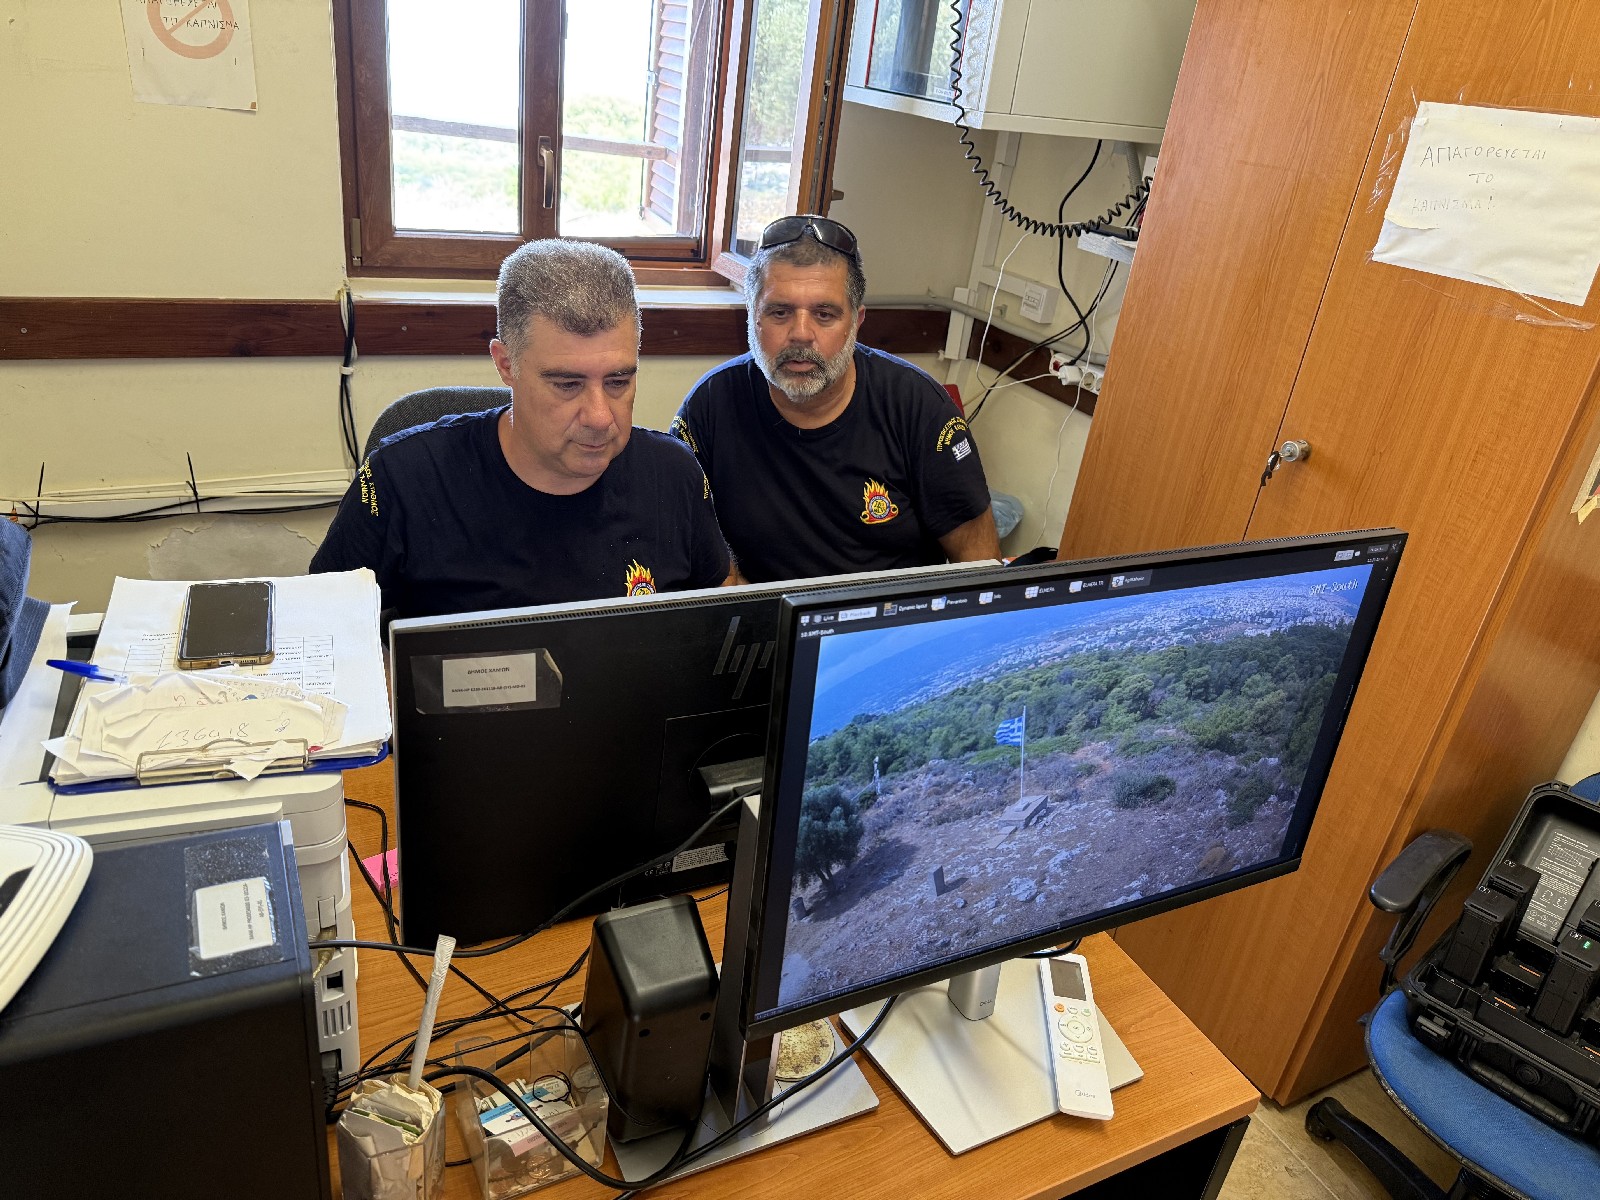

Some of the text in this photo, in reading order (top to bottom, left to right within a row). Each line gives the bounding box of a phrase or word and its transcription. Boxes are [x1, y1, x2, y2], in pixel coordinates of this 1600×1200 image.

[186, 19, 240, 30] ΚΑΠΝΙΣΜΑ
[1420, 145, 1547, 167] ΑΠΑΓΟΡΕΥΕΤΑΙ
[1468, 172, 1494, 184] ΤΟ
